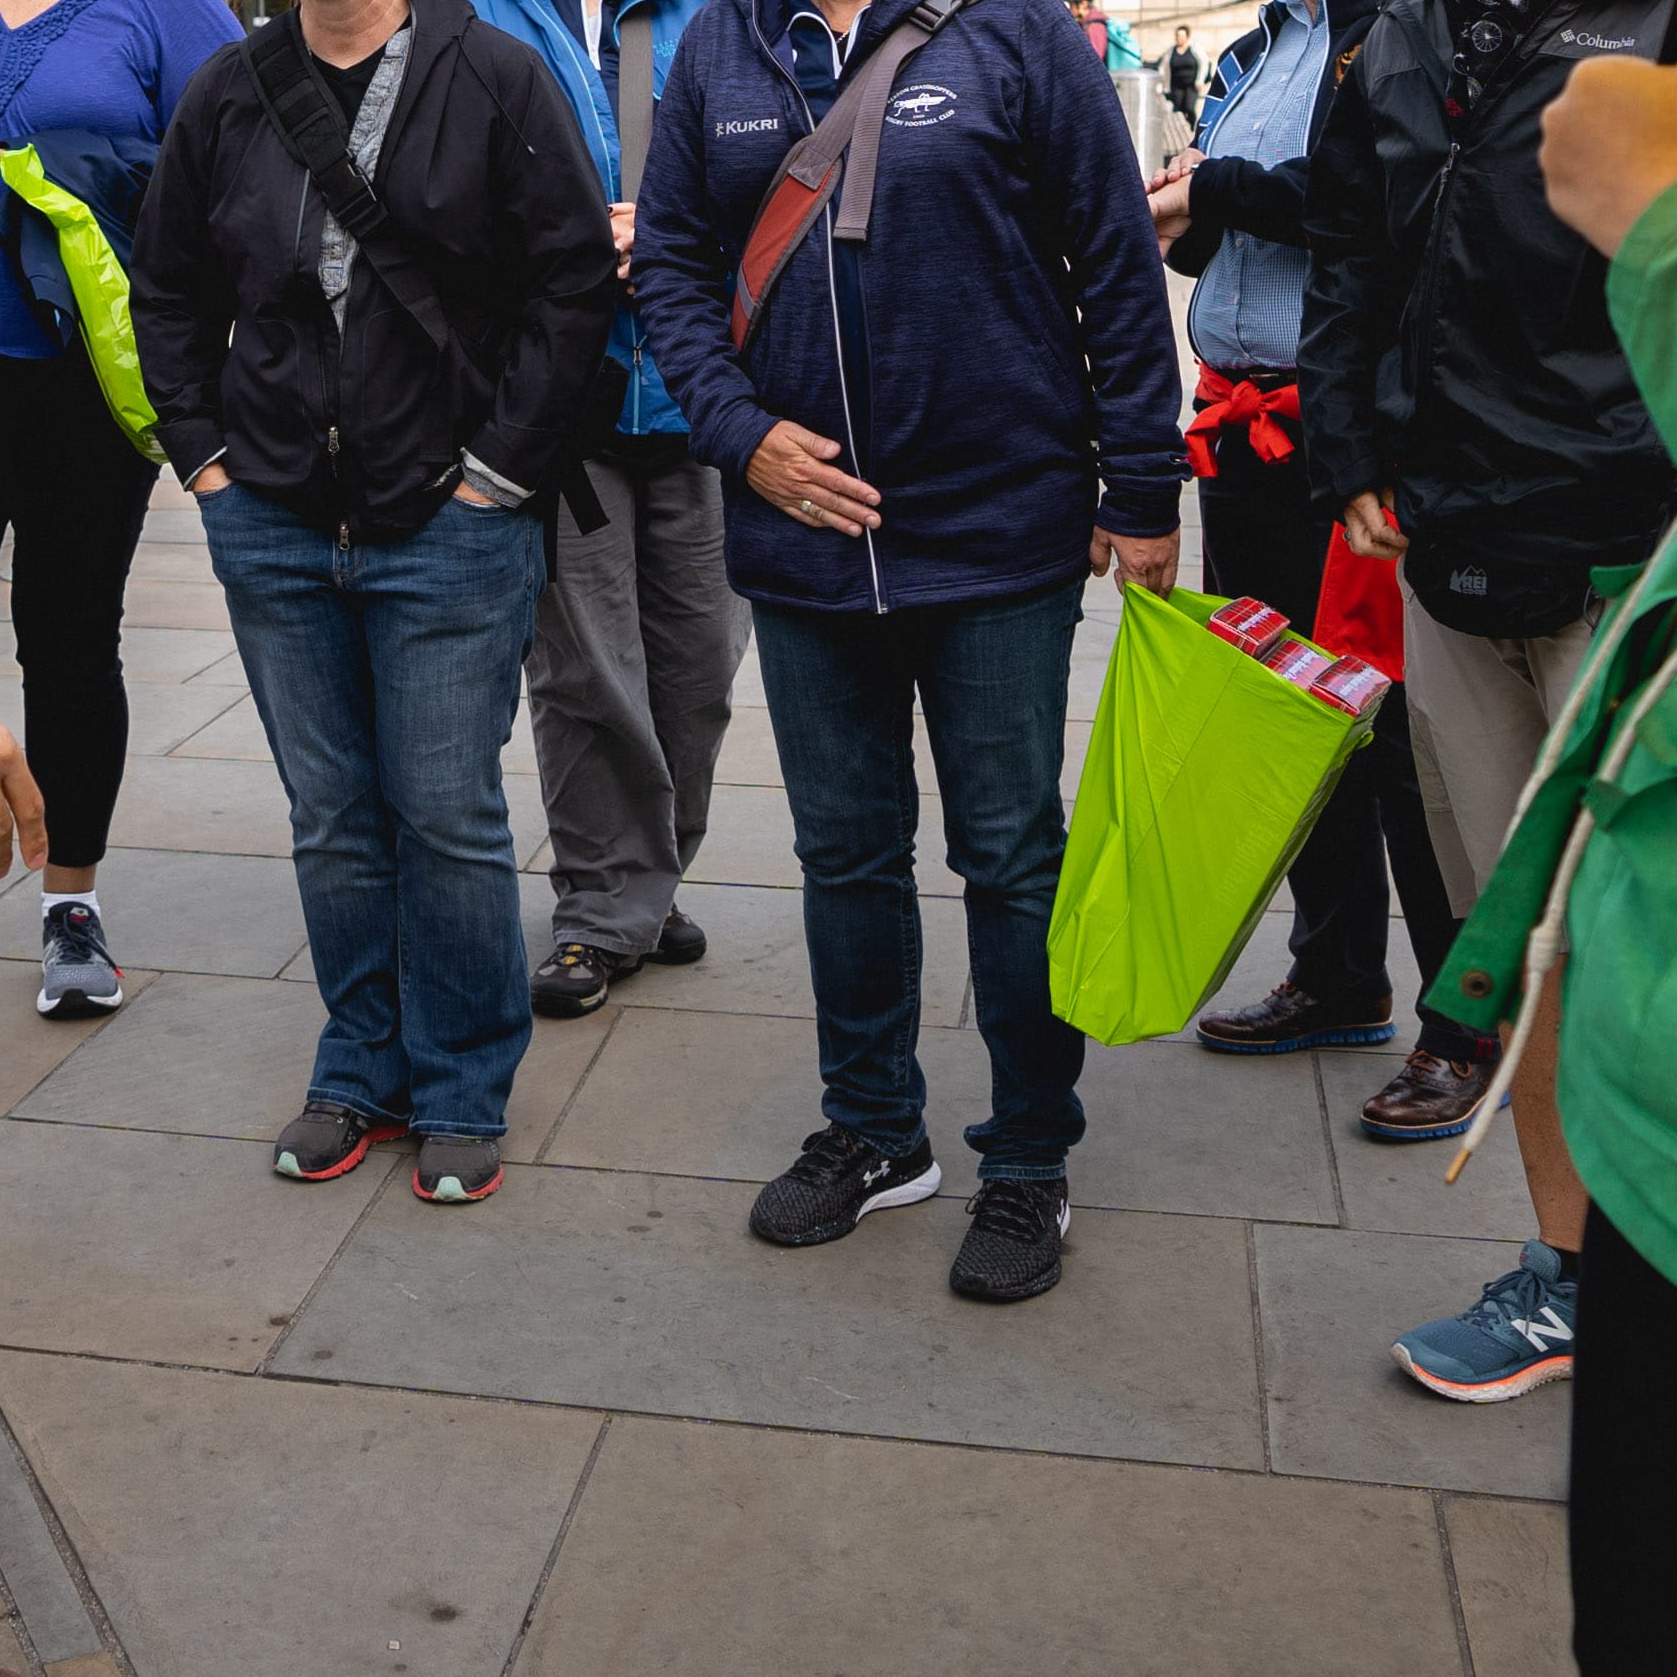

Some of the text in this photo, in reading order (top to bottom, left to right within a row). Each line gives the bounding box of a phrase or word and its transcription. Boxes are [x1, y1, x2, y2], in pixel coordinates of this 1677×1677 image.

[1576, 32, 1636, 50] Columbia
[938, 109, 956, 121] CLUB
[725, 118, 779, 135] KUKRI
